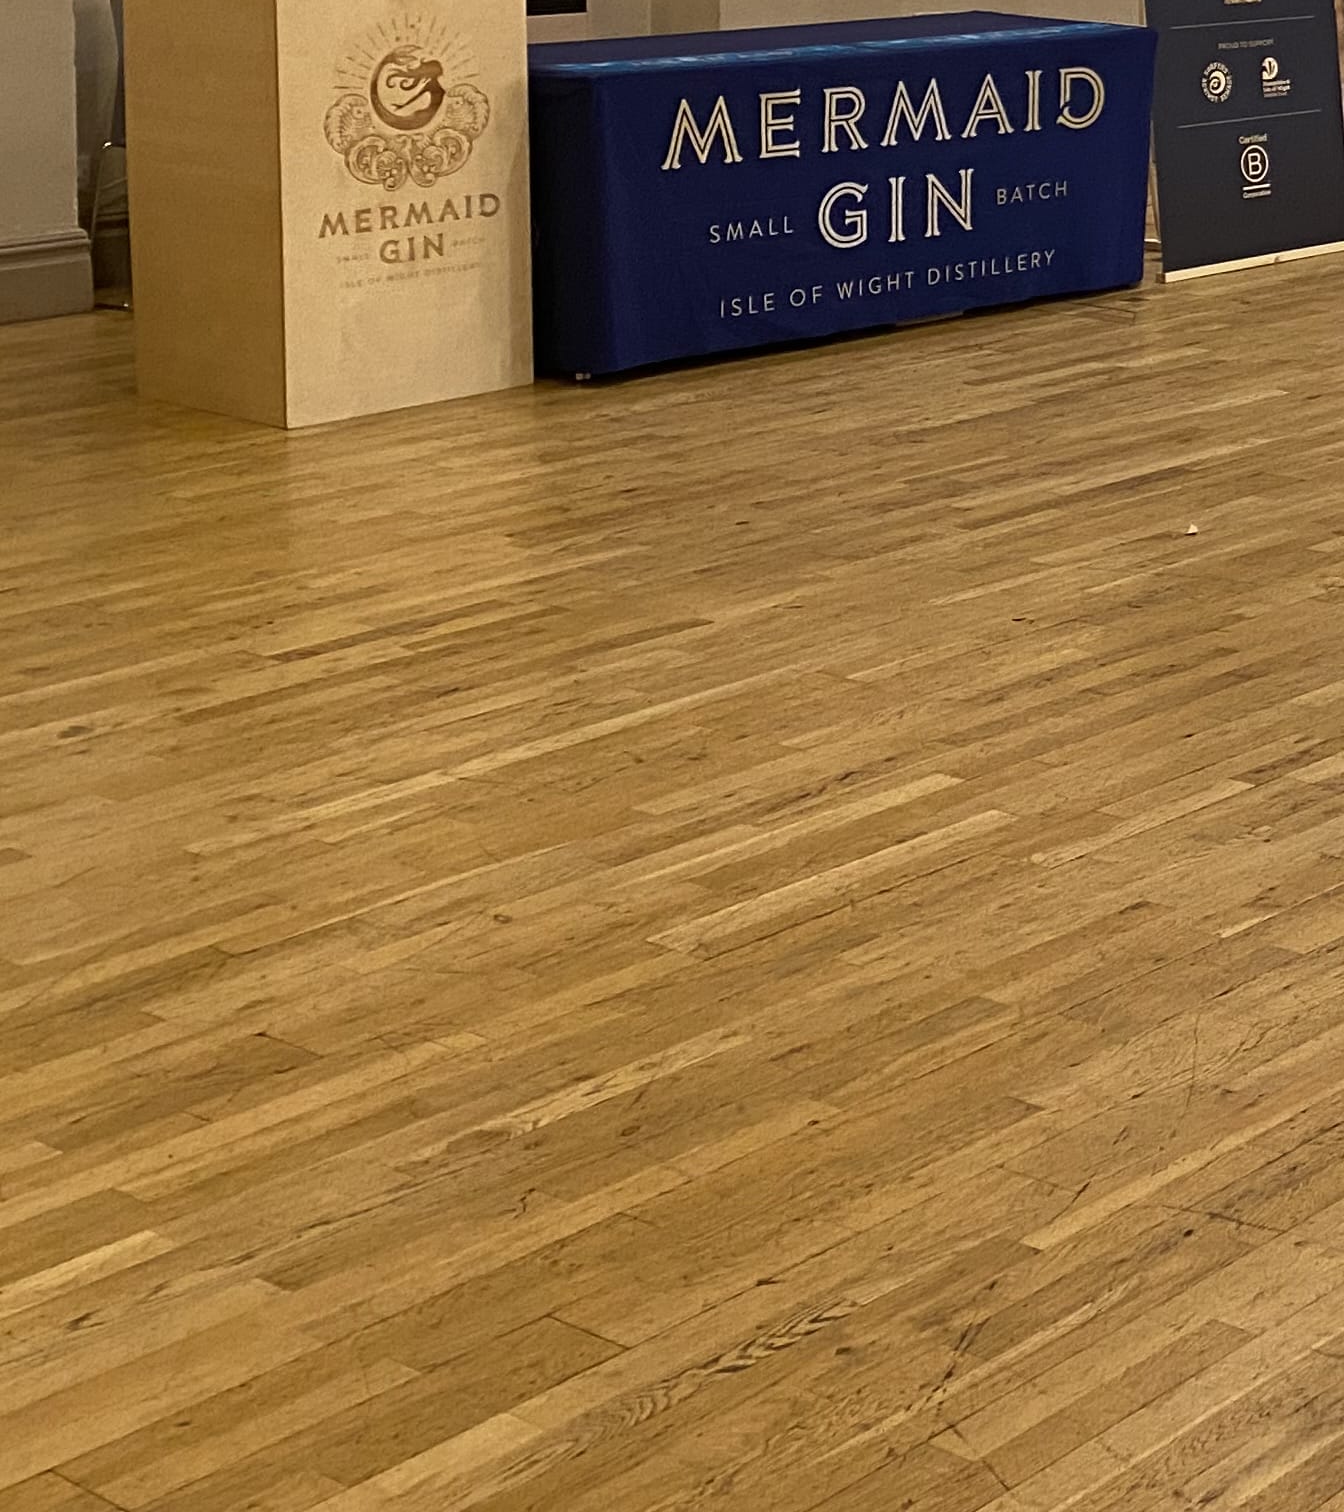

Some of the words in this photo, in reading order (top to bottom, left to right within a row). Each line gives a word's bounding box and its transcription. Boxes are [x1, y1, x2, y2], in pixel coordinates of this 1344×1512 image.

[660, 66, 1106, 170] MERMAID
[318, 193, 500, 238] MERMAID
[709, 216, 795, 243] SMALL
[818, 168, 975, 249] GIN
[996, 181, 1068, 205] BATCH
[379, 233, 444, 263] GIN
[720, 293, 776, 318] ISLE
[789, 285, 824, 307] OF
[836, 271, 915, 300] WIGHT
[928, 249, 1056, 285] DISTILLERY
